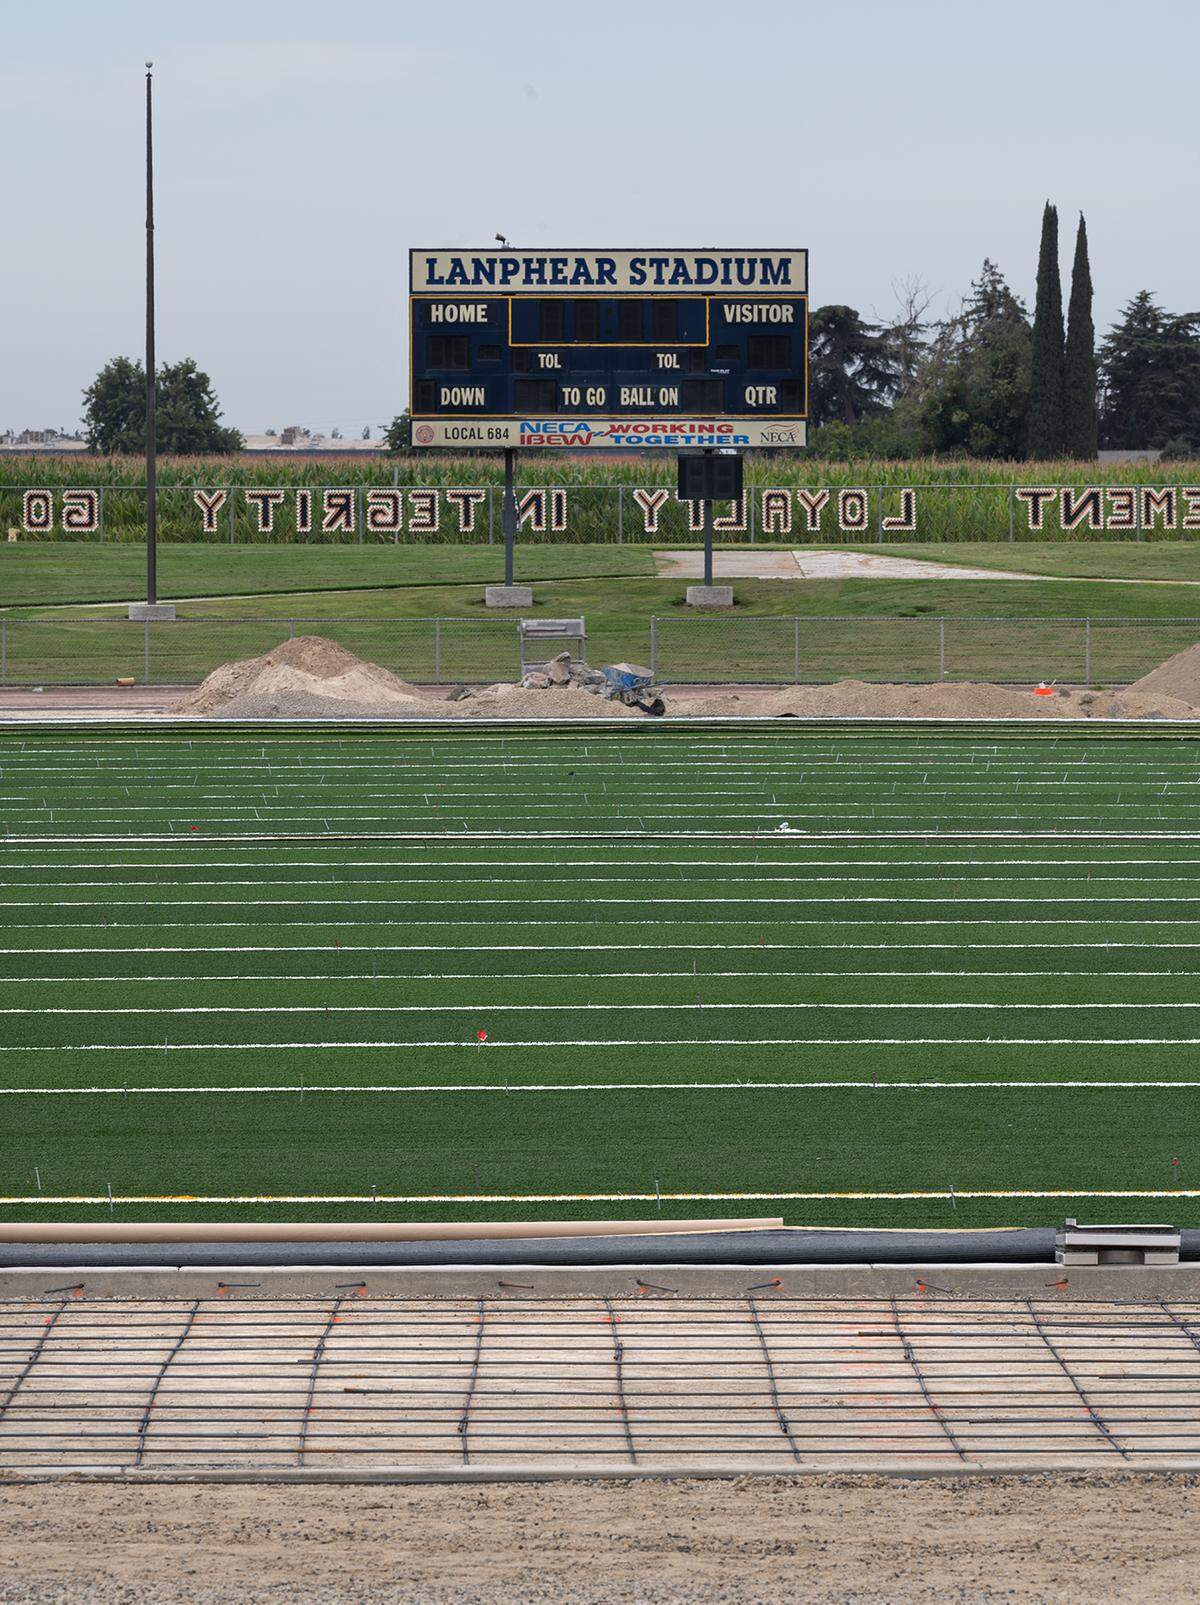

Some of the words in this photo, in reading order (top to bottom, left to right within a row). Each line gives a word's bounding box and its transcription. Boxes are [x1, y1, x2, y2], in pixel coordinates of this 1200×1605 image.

[425, 257, 618, 286] LANPHEAR
[629, 257, 792, 286] STADIUM
[430, 304, 488, 323] HOME
[723, 304, 794, 323] VISITOR
[538, 353, 562, 369] TOL
[656, 353, 680, 369] TOL
[440, 387, 486, 406] DOWN
[562, 387, 581, 406] TO
[586, 387, 606, 406] GO
[620, 387, 655, 406] BALL
[659, 387, 679, 406] ON
[744, 385, 777, 405] QTR
[444, 427, 484, 440] LOCAL
[487, 427, 510, 440] 684
[519, 422, 591, 433] NECA
[608, 423, 735, 434] WORKING
[519, 433, 595, 446] IBEW
[610, 434, 750, 445] TOGETHER
[759, 431, 796, 443] NECA
